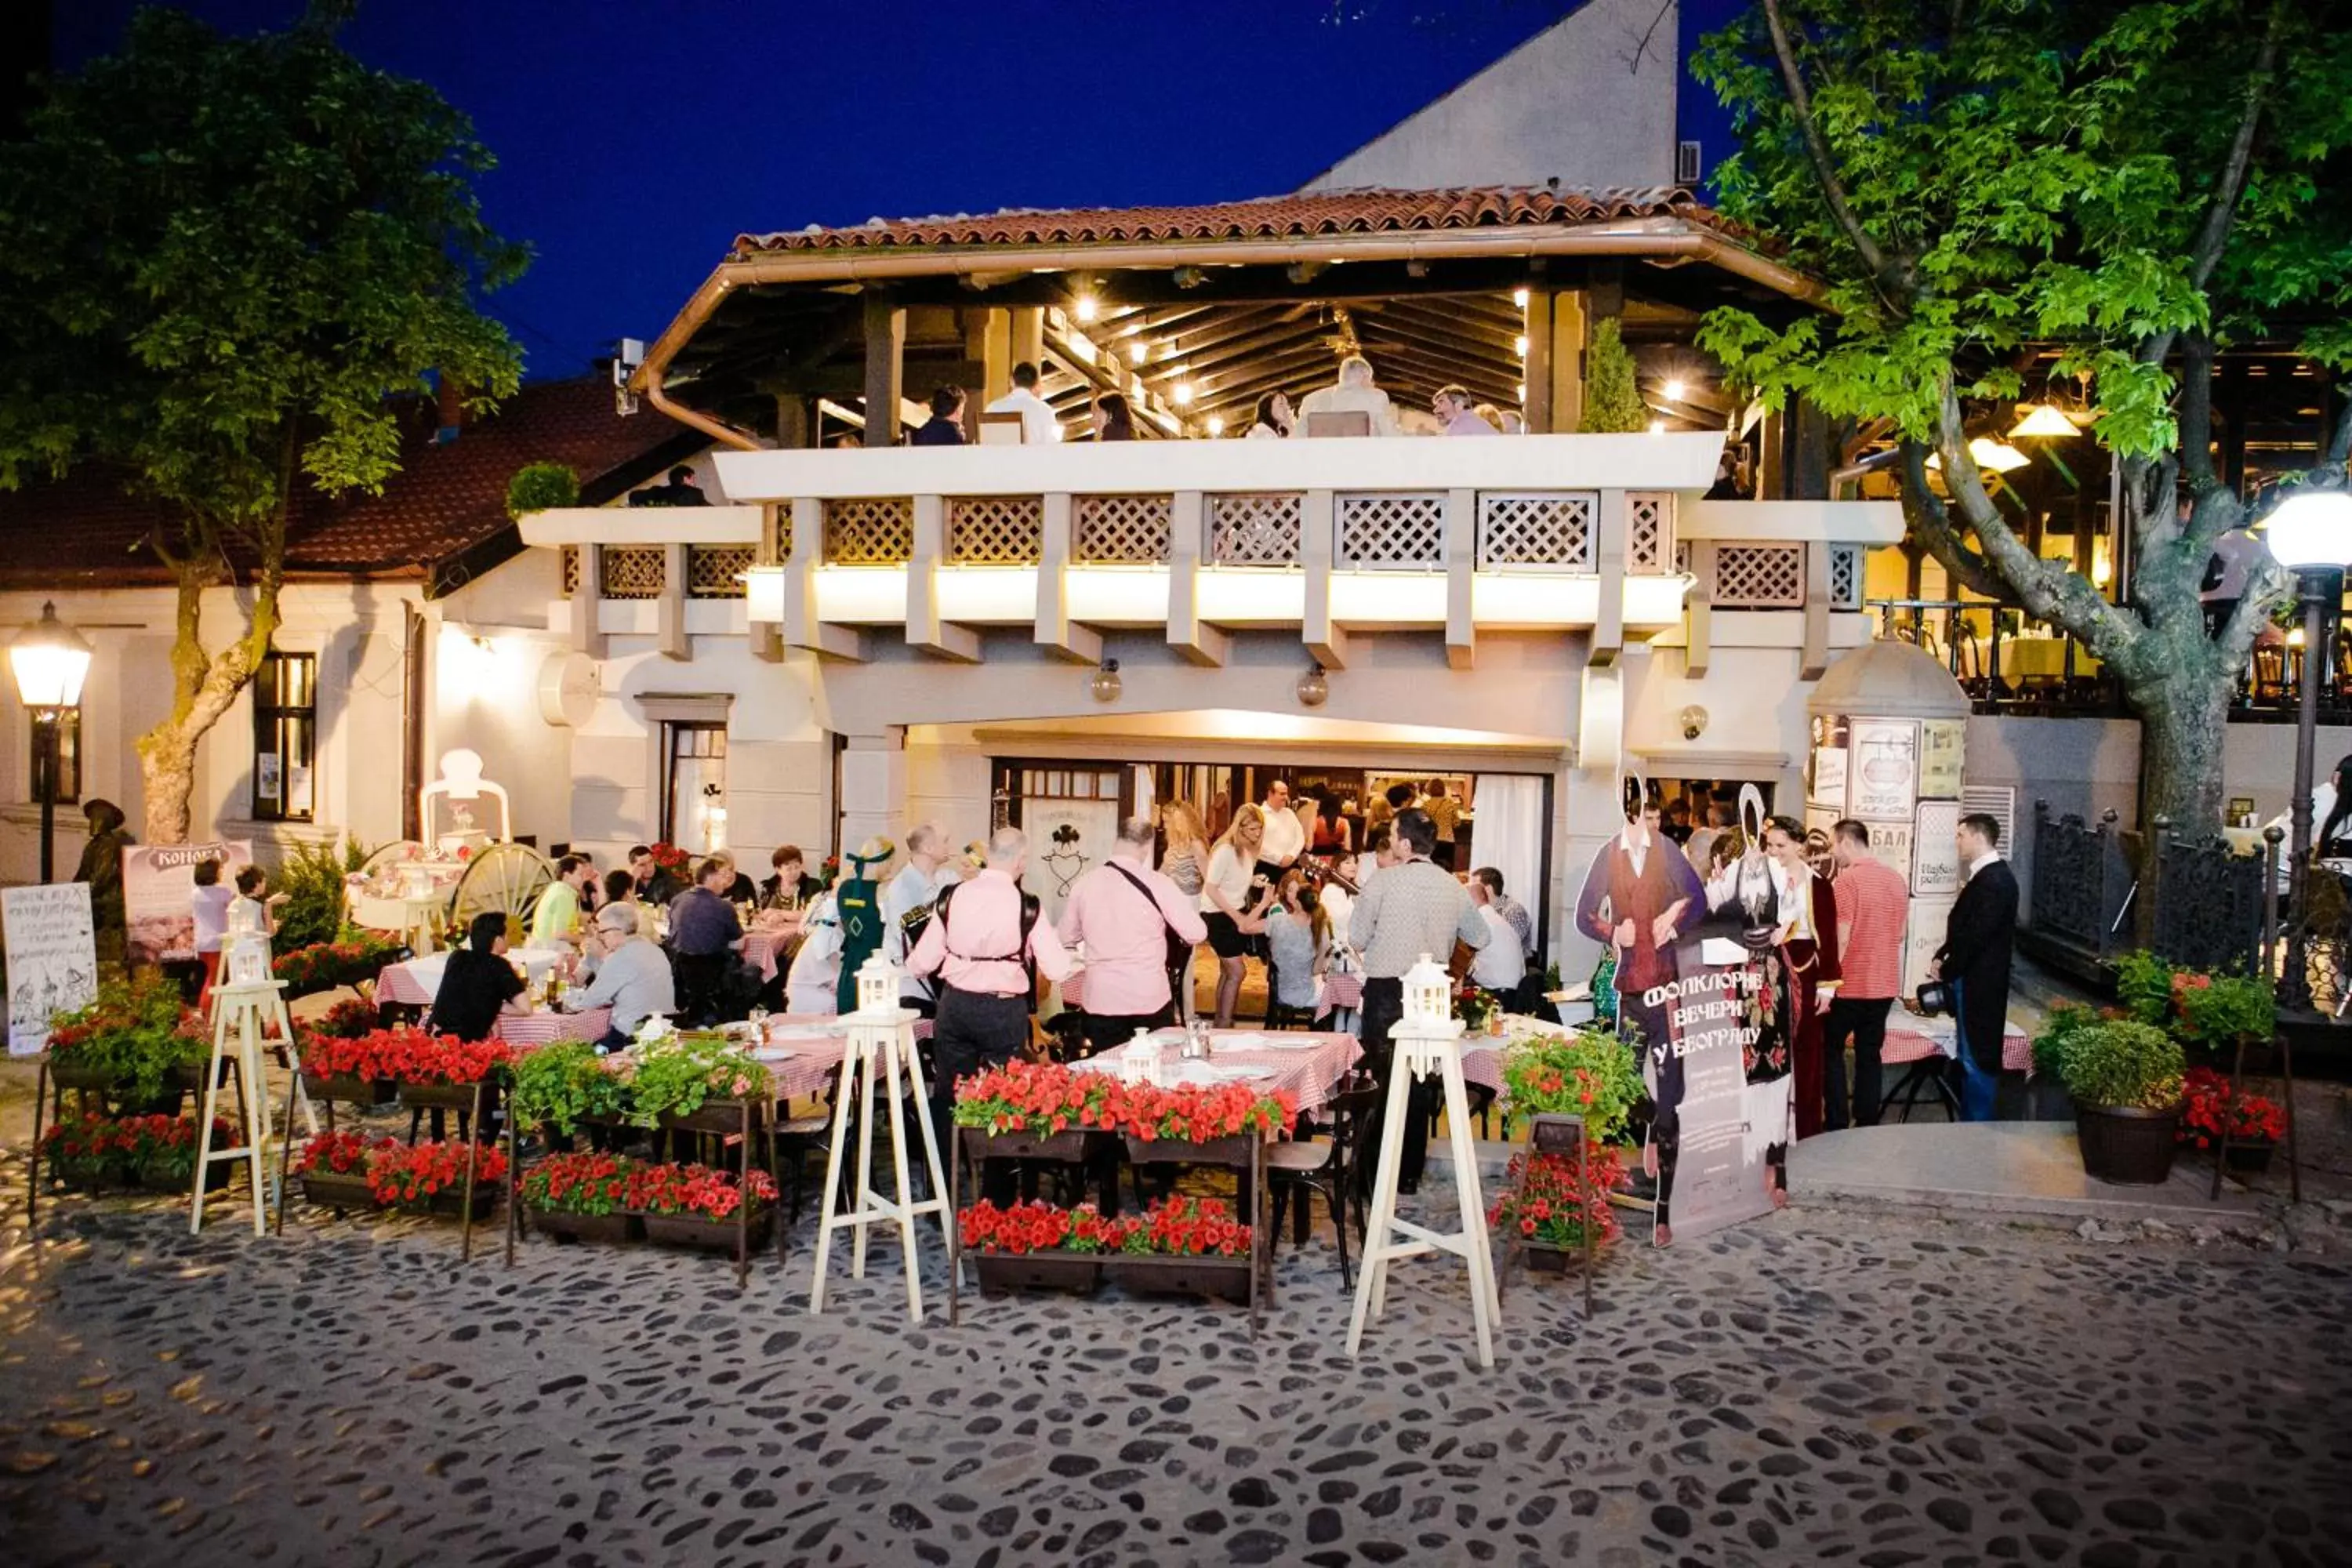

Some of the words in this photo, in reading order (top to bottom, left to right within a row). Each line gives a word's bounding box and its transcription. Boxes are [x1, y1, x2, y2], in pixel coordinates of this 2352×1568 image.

[1642, 971, 1763, 1007] ФОЛКЛОРНЕ
[1673, 1000, 1744, 1028] ВЕЧЕРИ
[1653, 1043, 1668, 1065] У
[1672, 1027, 1761, 1059] БЕОГРАДУ
